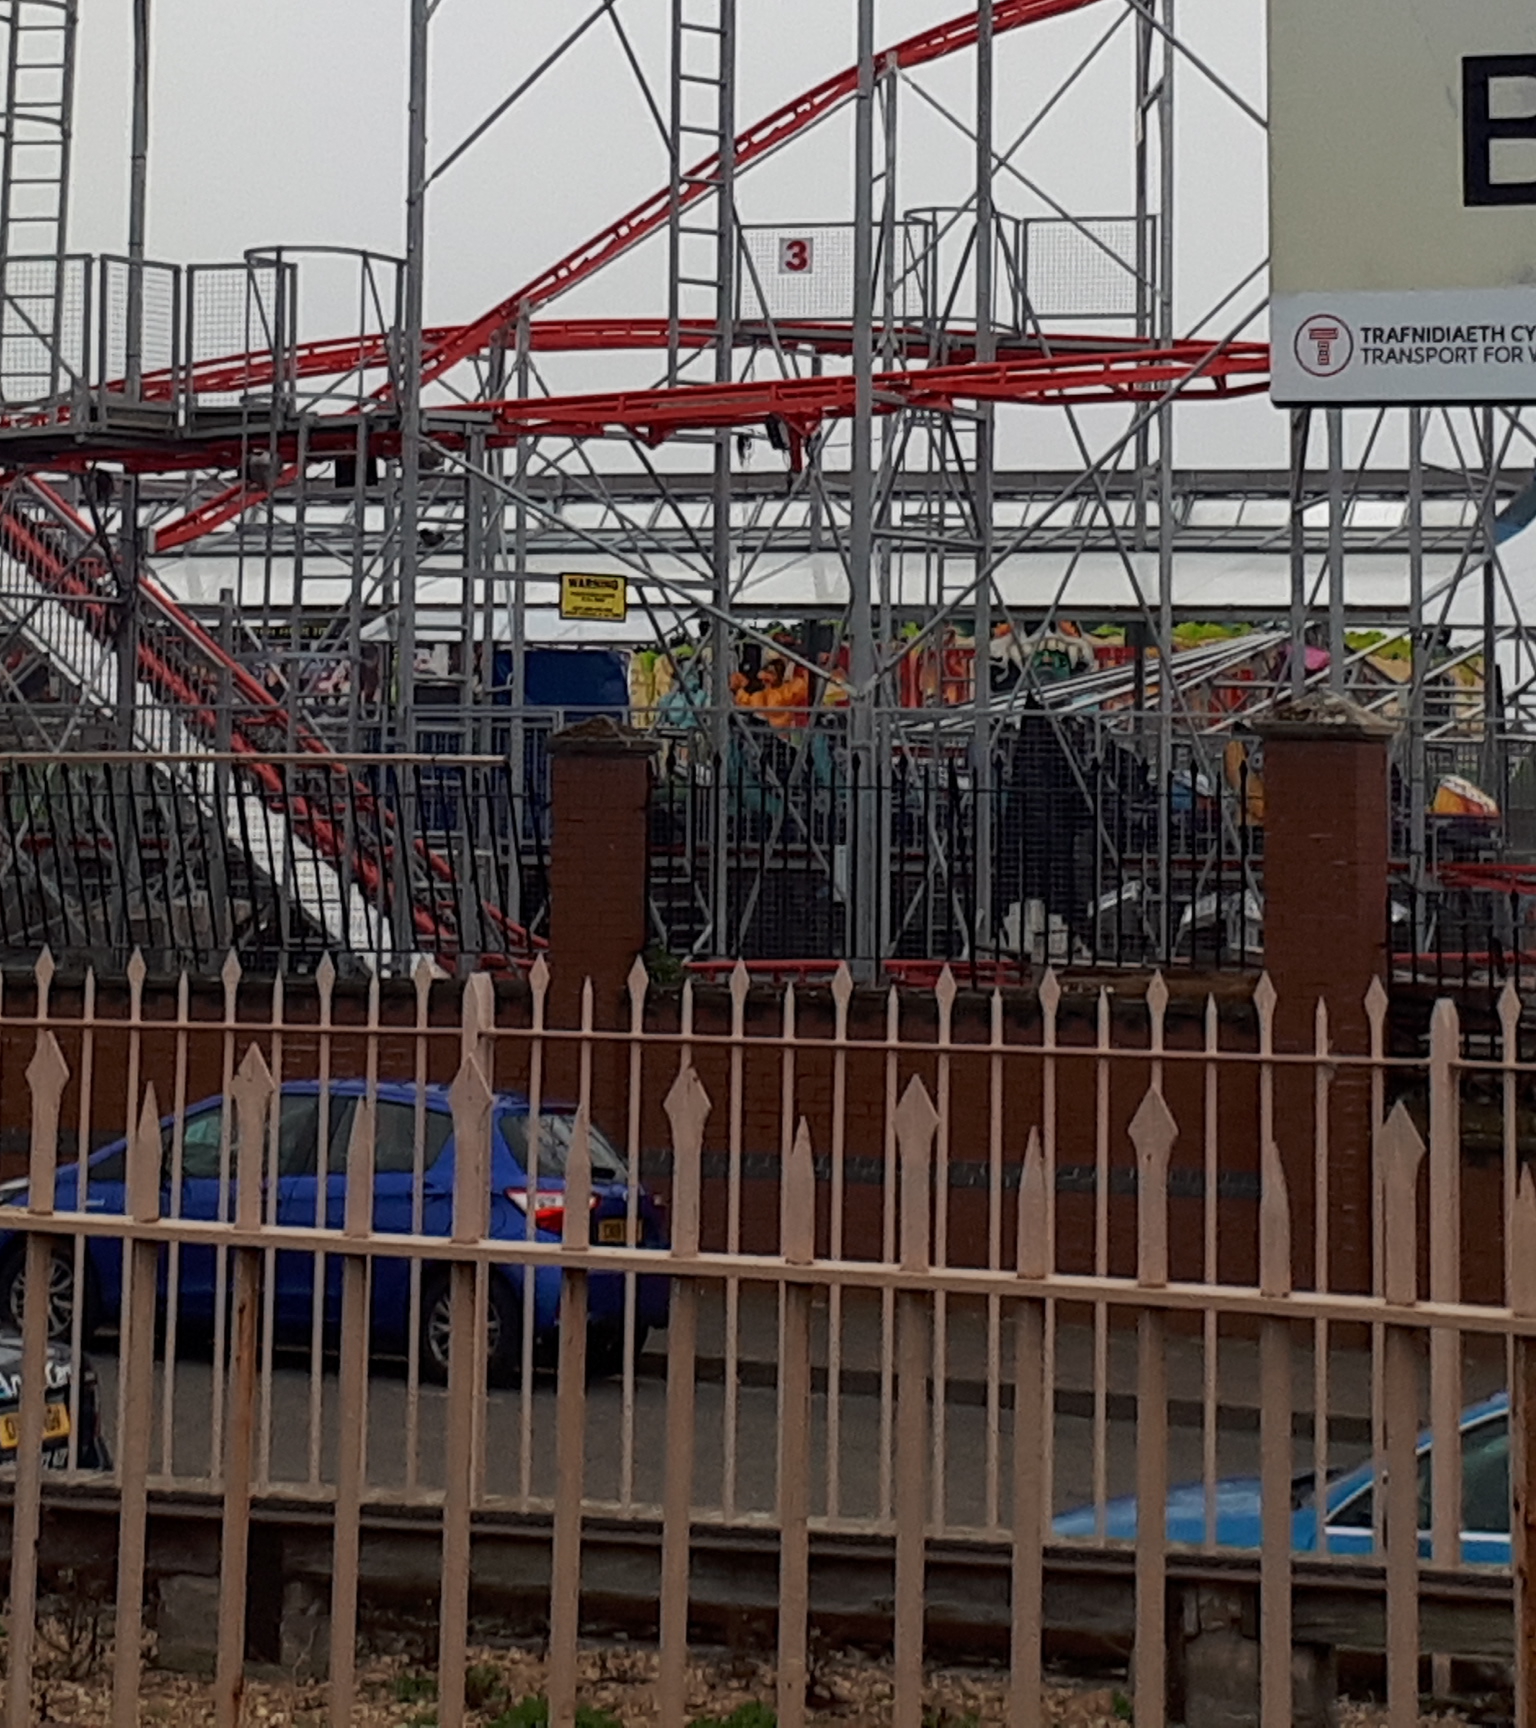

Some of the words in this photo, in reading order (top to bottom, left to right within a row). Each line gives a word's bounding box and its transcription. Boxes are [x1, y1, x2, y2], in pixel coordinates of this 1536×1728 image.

[785, 240, 808, 272] 3
[1360, 325, 1504, 344] TRAFNIDIAETH
[1360, 346, 1478, 365] TRANSPORT
[1483, 346, 1523, 363] FOR
